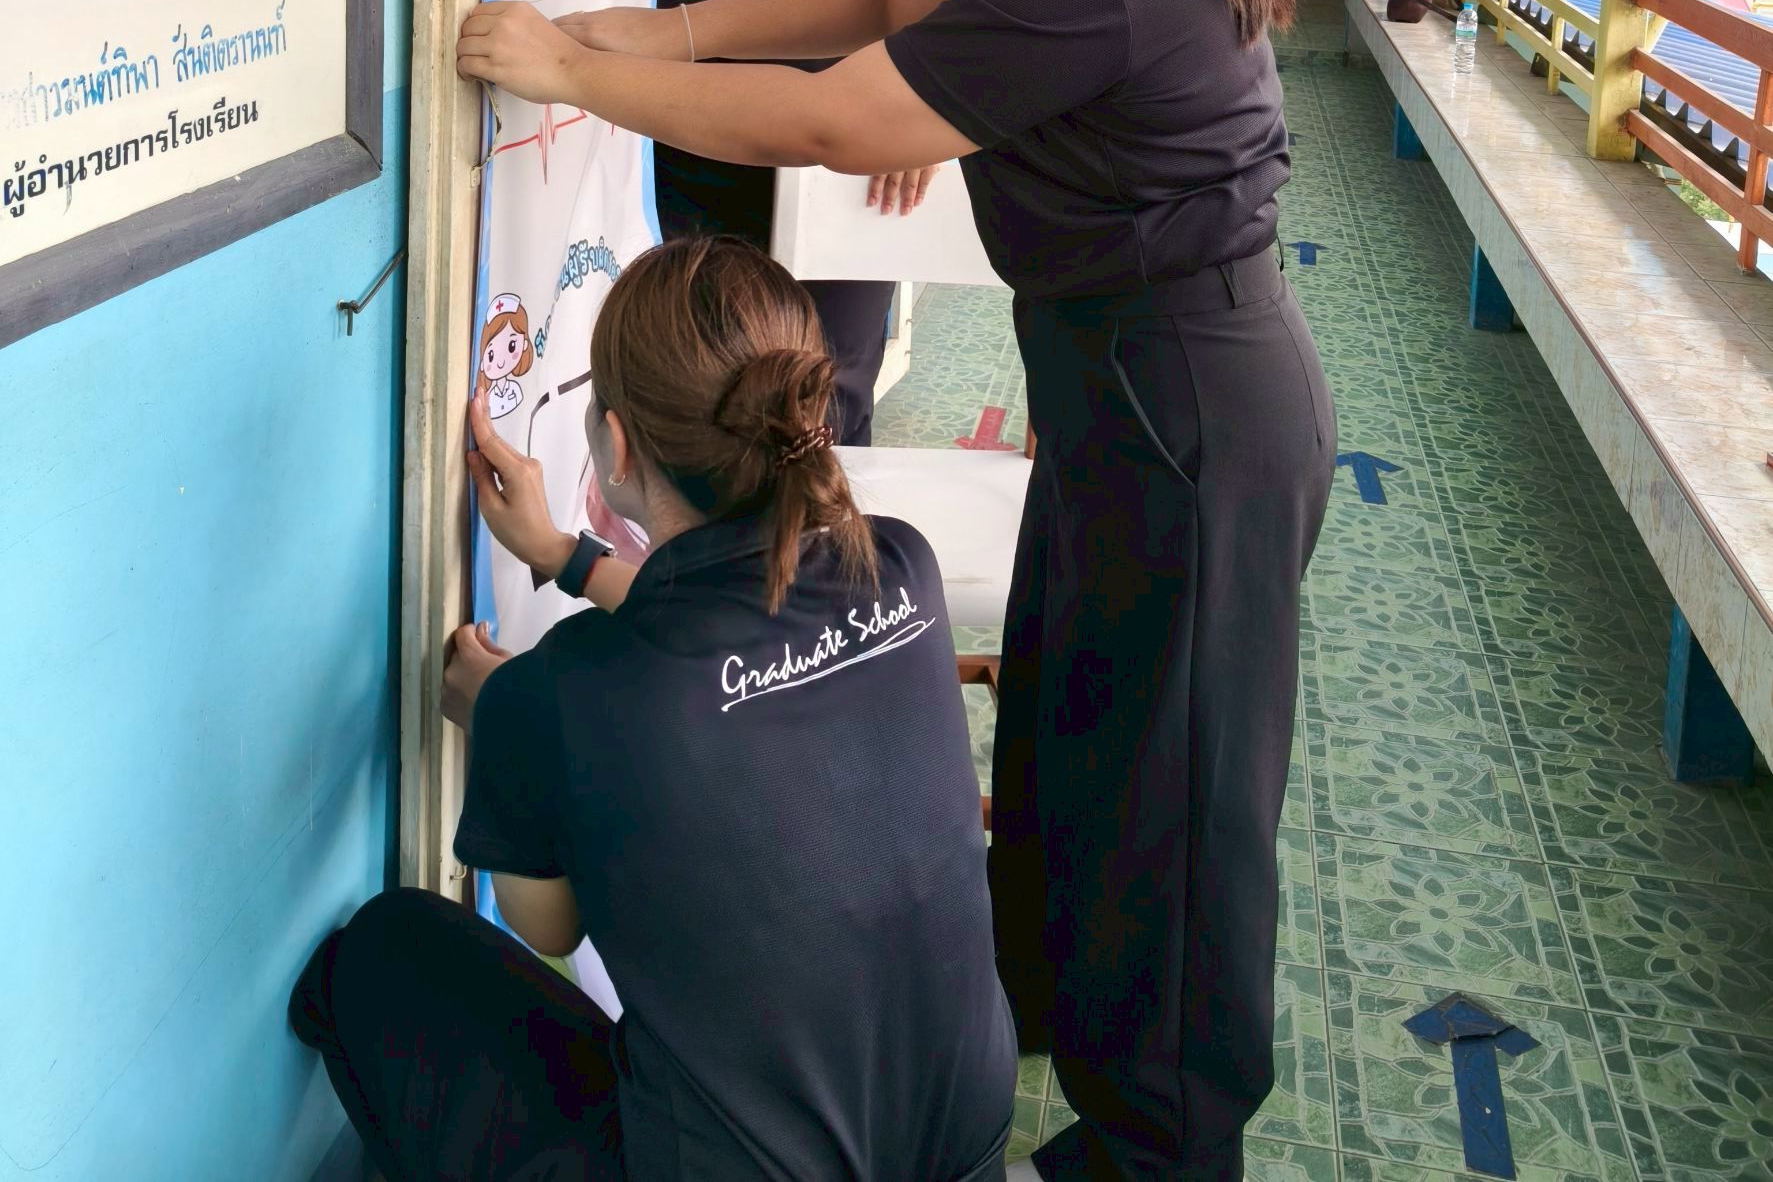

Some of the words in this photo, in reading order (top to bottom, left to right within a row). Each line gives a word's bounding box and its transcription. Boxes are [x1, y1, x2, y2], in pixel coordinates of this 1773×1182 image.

[3, 96, 259, 218] ผู้อำนวยการโรงเรียน
[721, 626, 848, 699] Graduate
[848, 587, 917, 642] School
